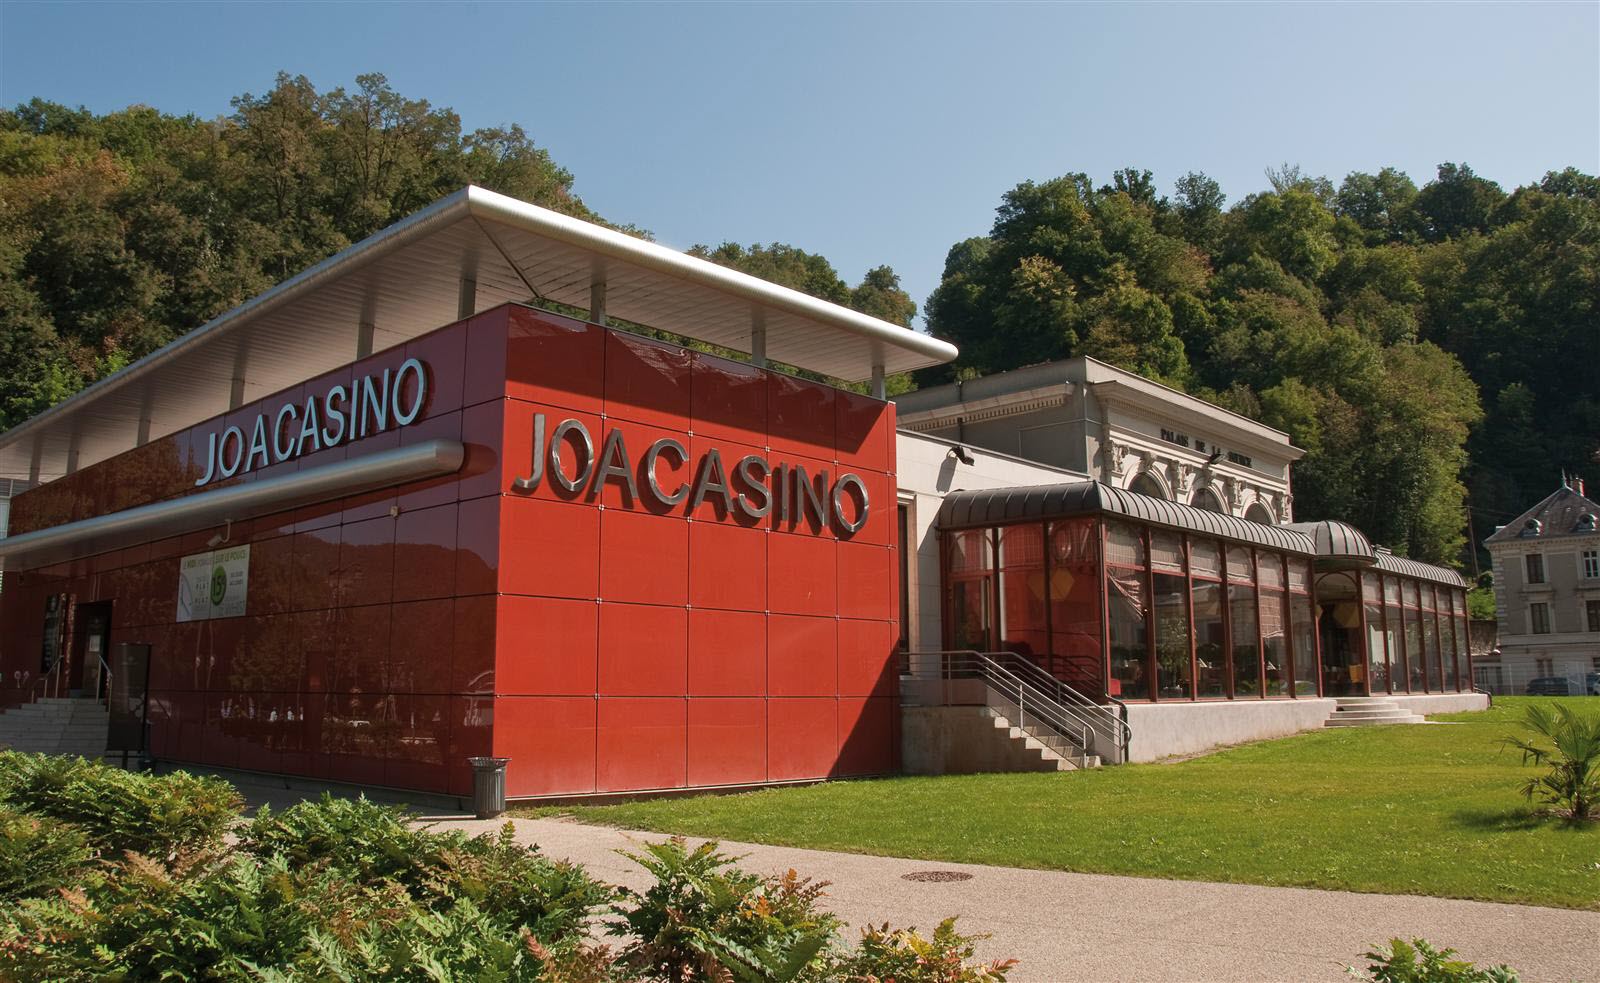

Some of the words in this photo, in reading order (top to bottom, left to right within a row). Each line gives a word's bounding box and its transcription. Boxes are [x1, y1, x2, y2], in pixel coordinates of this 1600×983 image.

[194, 358, 428, 487] JOACASINO
[513, 412, 871, 534] JOACASINO
[1160, 428, 1189, 447] PALAIS
